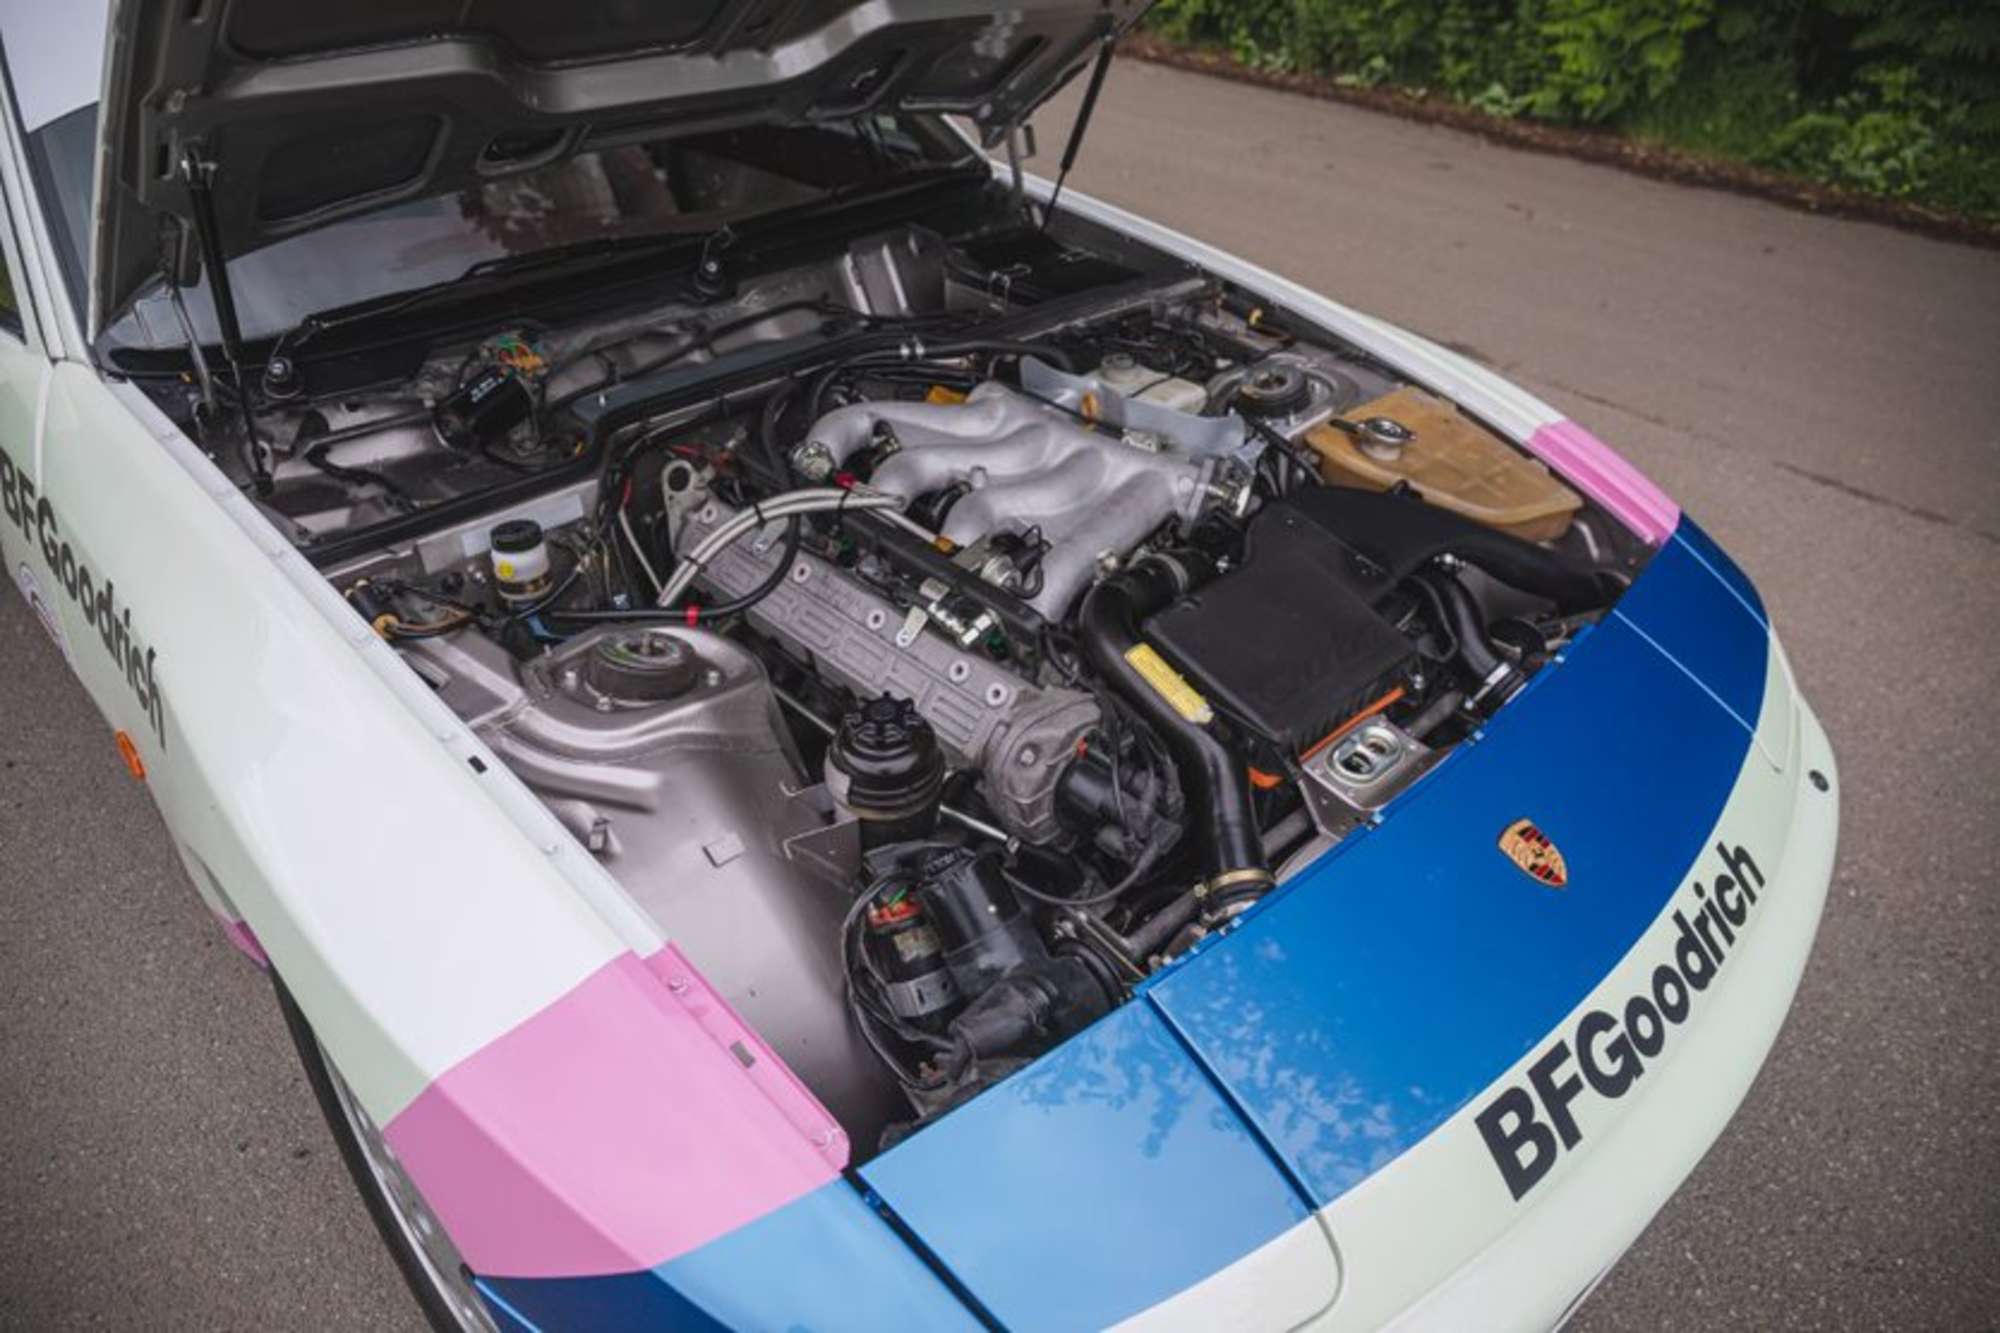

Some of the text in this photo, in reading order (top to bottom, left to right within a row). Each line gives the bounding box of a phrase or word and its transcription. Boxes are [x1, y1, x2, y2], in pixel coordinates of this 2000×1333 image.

[0, 445, 166, 752] BFGoodrich
[688, 531, 986, 752] ORSCHE
[1474, 841, 1766, 1202] BFGoodrich
